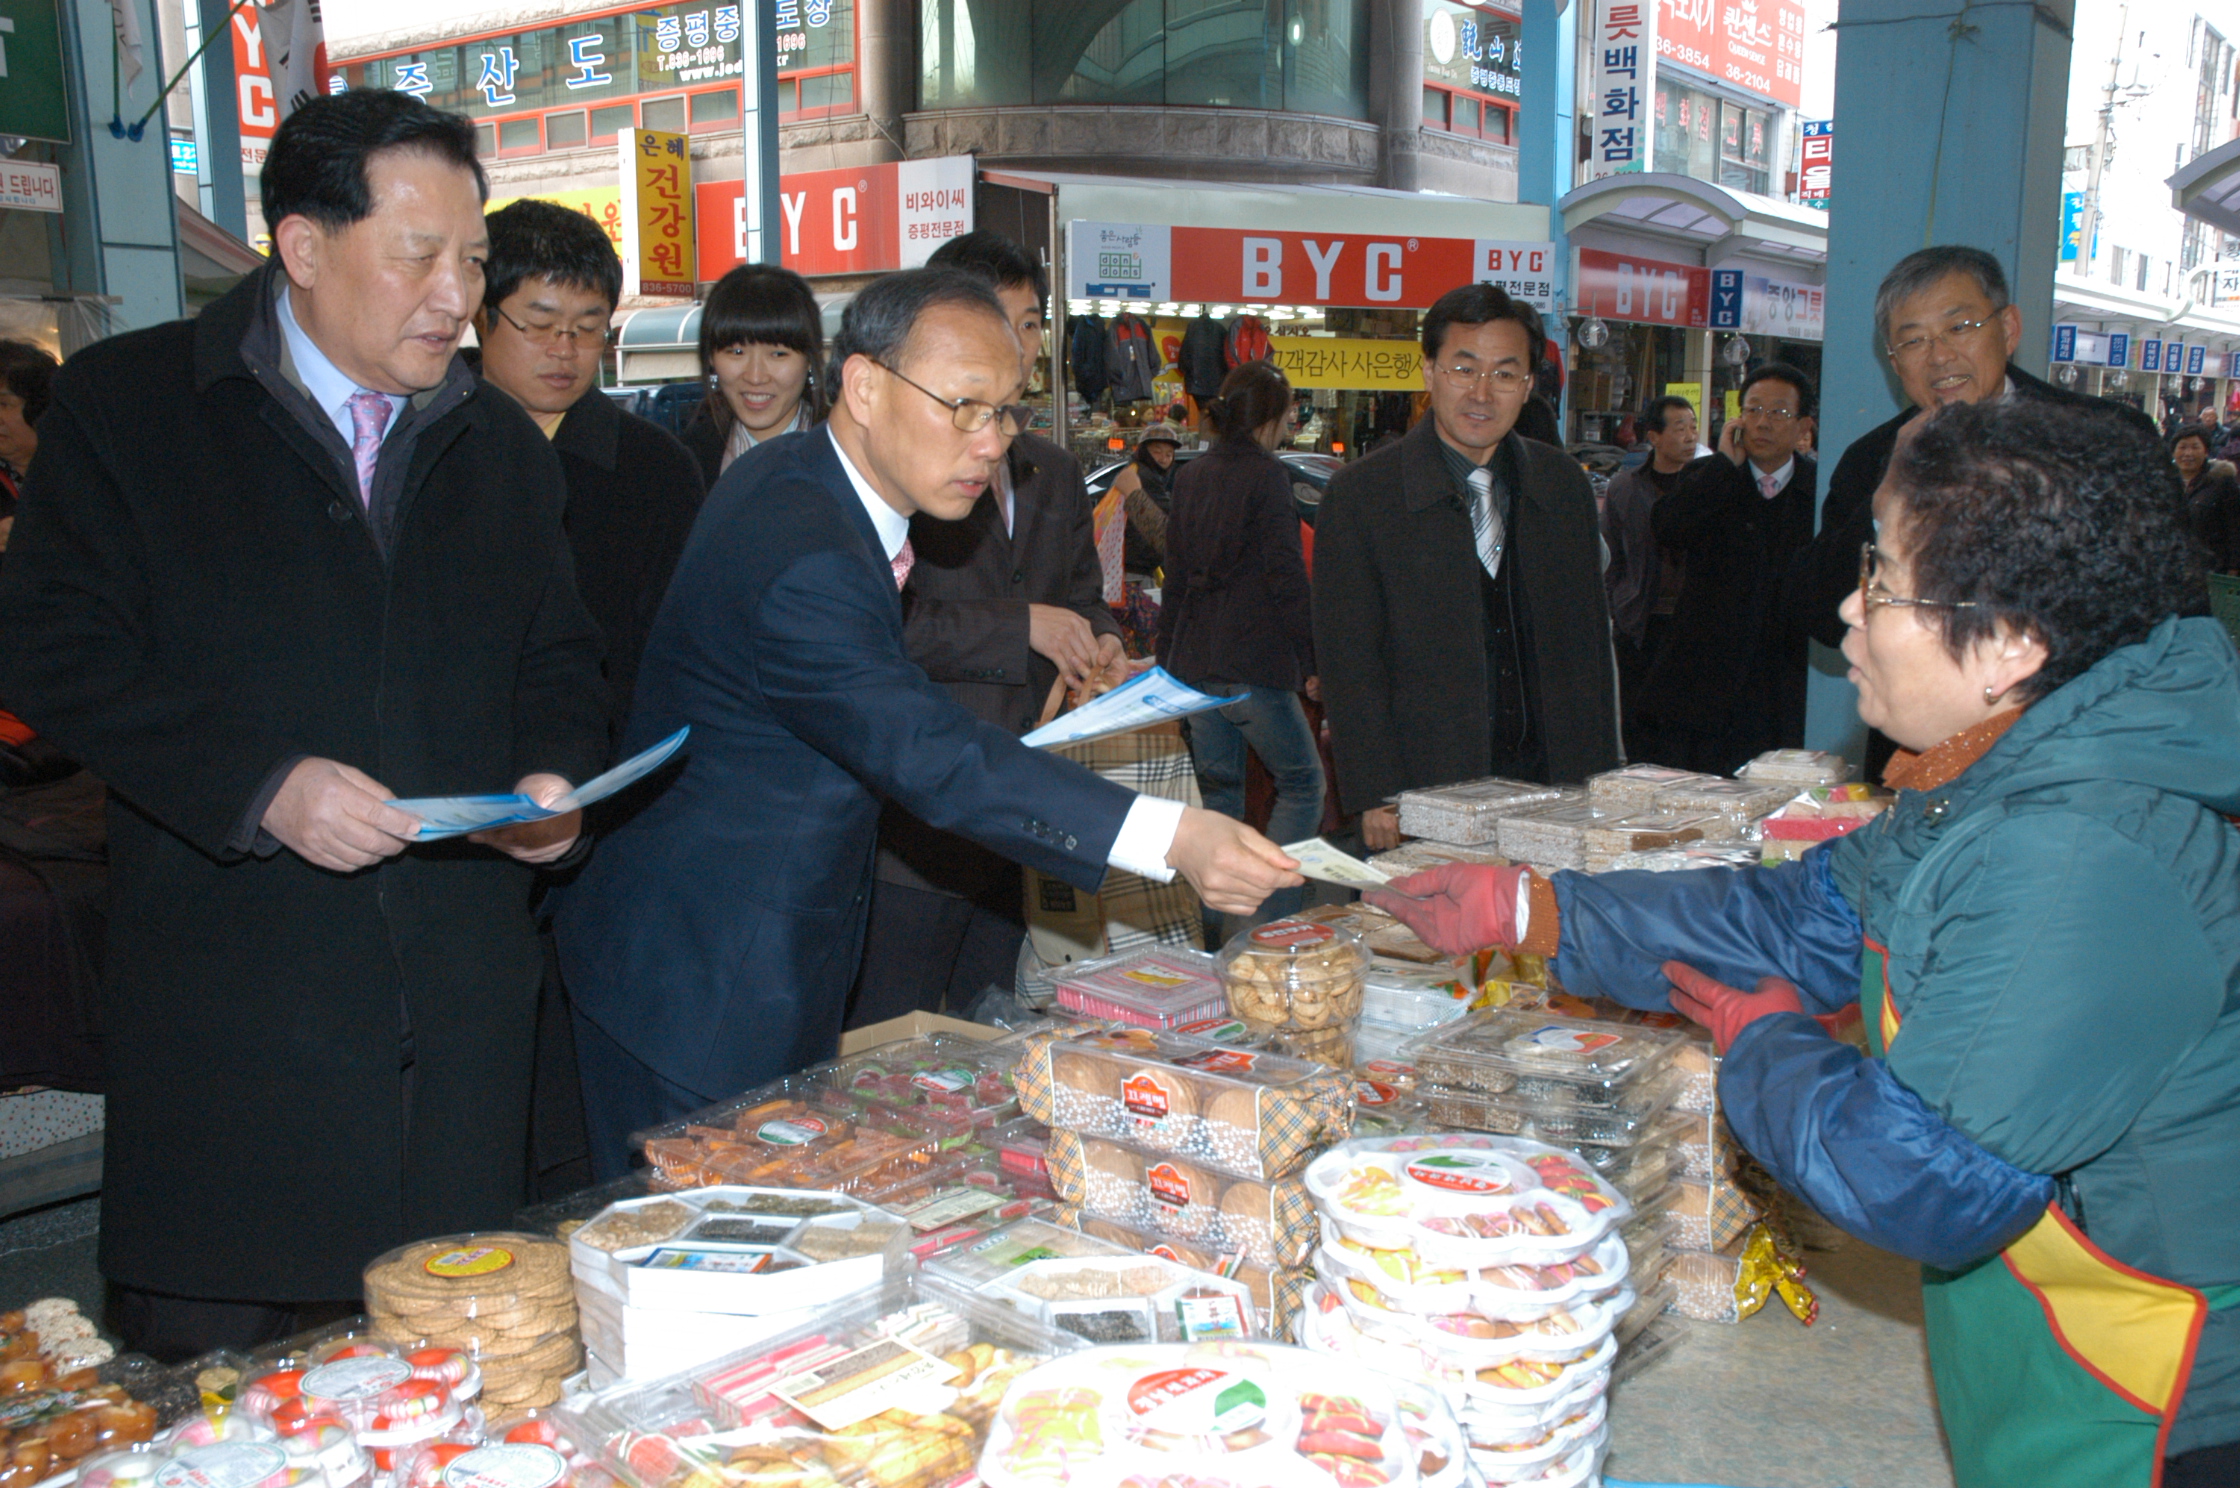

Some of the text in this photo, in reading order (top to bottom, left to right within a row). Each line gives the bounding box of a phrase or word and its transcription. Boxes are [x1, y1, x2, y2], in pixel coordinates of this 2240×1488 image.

[1723, 6, 1773, 47] 퀸센스
[232, 0, 276, 128] YC
[1656, 35, 1710, 69] 36-3854
[1725, 62, 1771, 93] 36-2104
[640, 134, 685, 161] 은혜
[10, 174, 54, 199] 드립니다
[905, 188, 965, 213] 비와이씨
[646, 164, 687, 277] 건강원
[907, 220, 965, 239] 증평전문점
[1102, 254, 1129, 265] don
[1102, 265, 1139, 277] dons
[1242, 237, 1403, 302] BYC
[1488, 249, 1543, 272] BYC
[642, 282, 692, 294] 836-5700
[1481, 280, 1550, 297] 전문점
[1616, 263, 1678, 320] BYC
[1717, 273, 1736, 325] BYC
[1767, 284, 1823, 322] 중앙그릇
